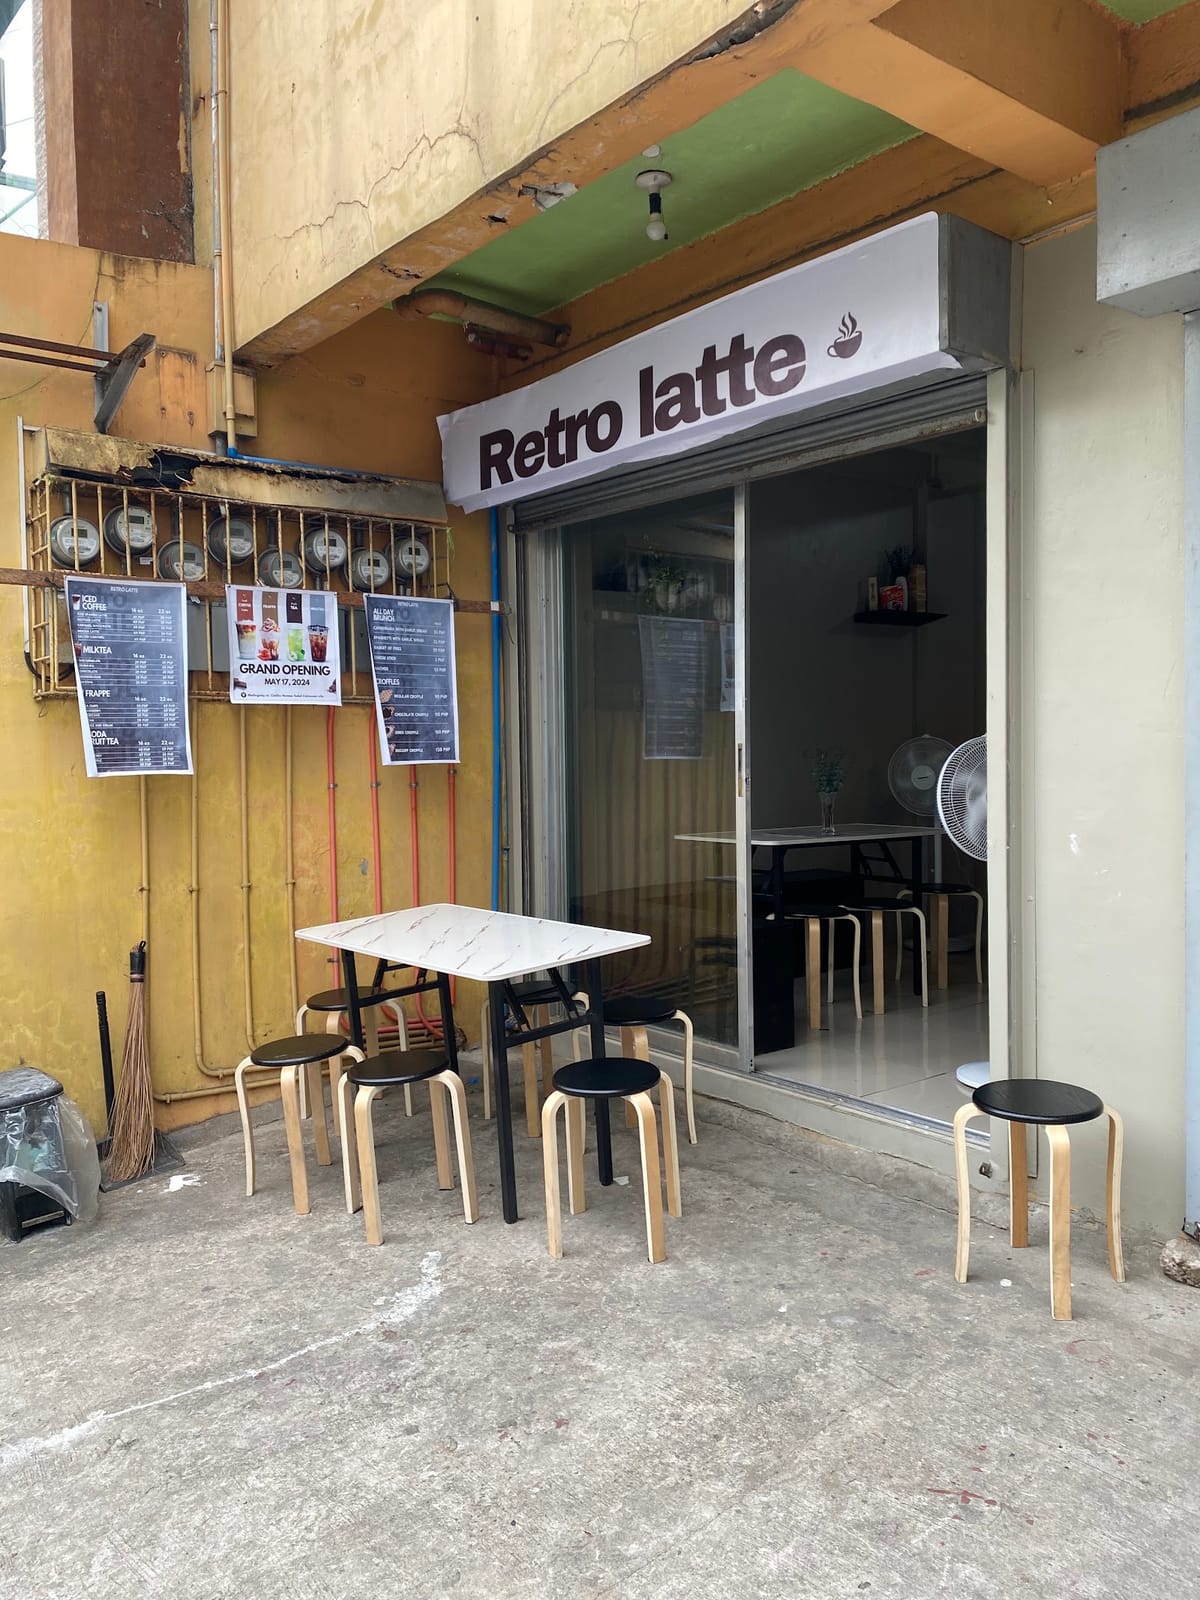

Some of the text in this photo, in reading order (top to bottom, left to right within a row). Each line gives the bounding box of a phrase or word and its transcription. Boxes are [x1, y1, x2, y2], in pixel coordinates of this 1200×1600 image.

[479, 333, 806, 491] Retro latte
[82, 595, 97, 603] ICED
[82, 603, 107, 611] COFFEE
[82, 646, 112, 655] MILKTEA
[240, 664, 331, 676] GRAND OPENING
[85, 690, 111, 698] FRAPPE
